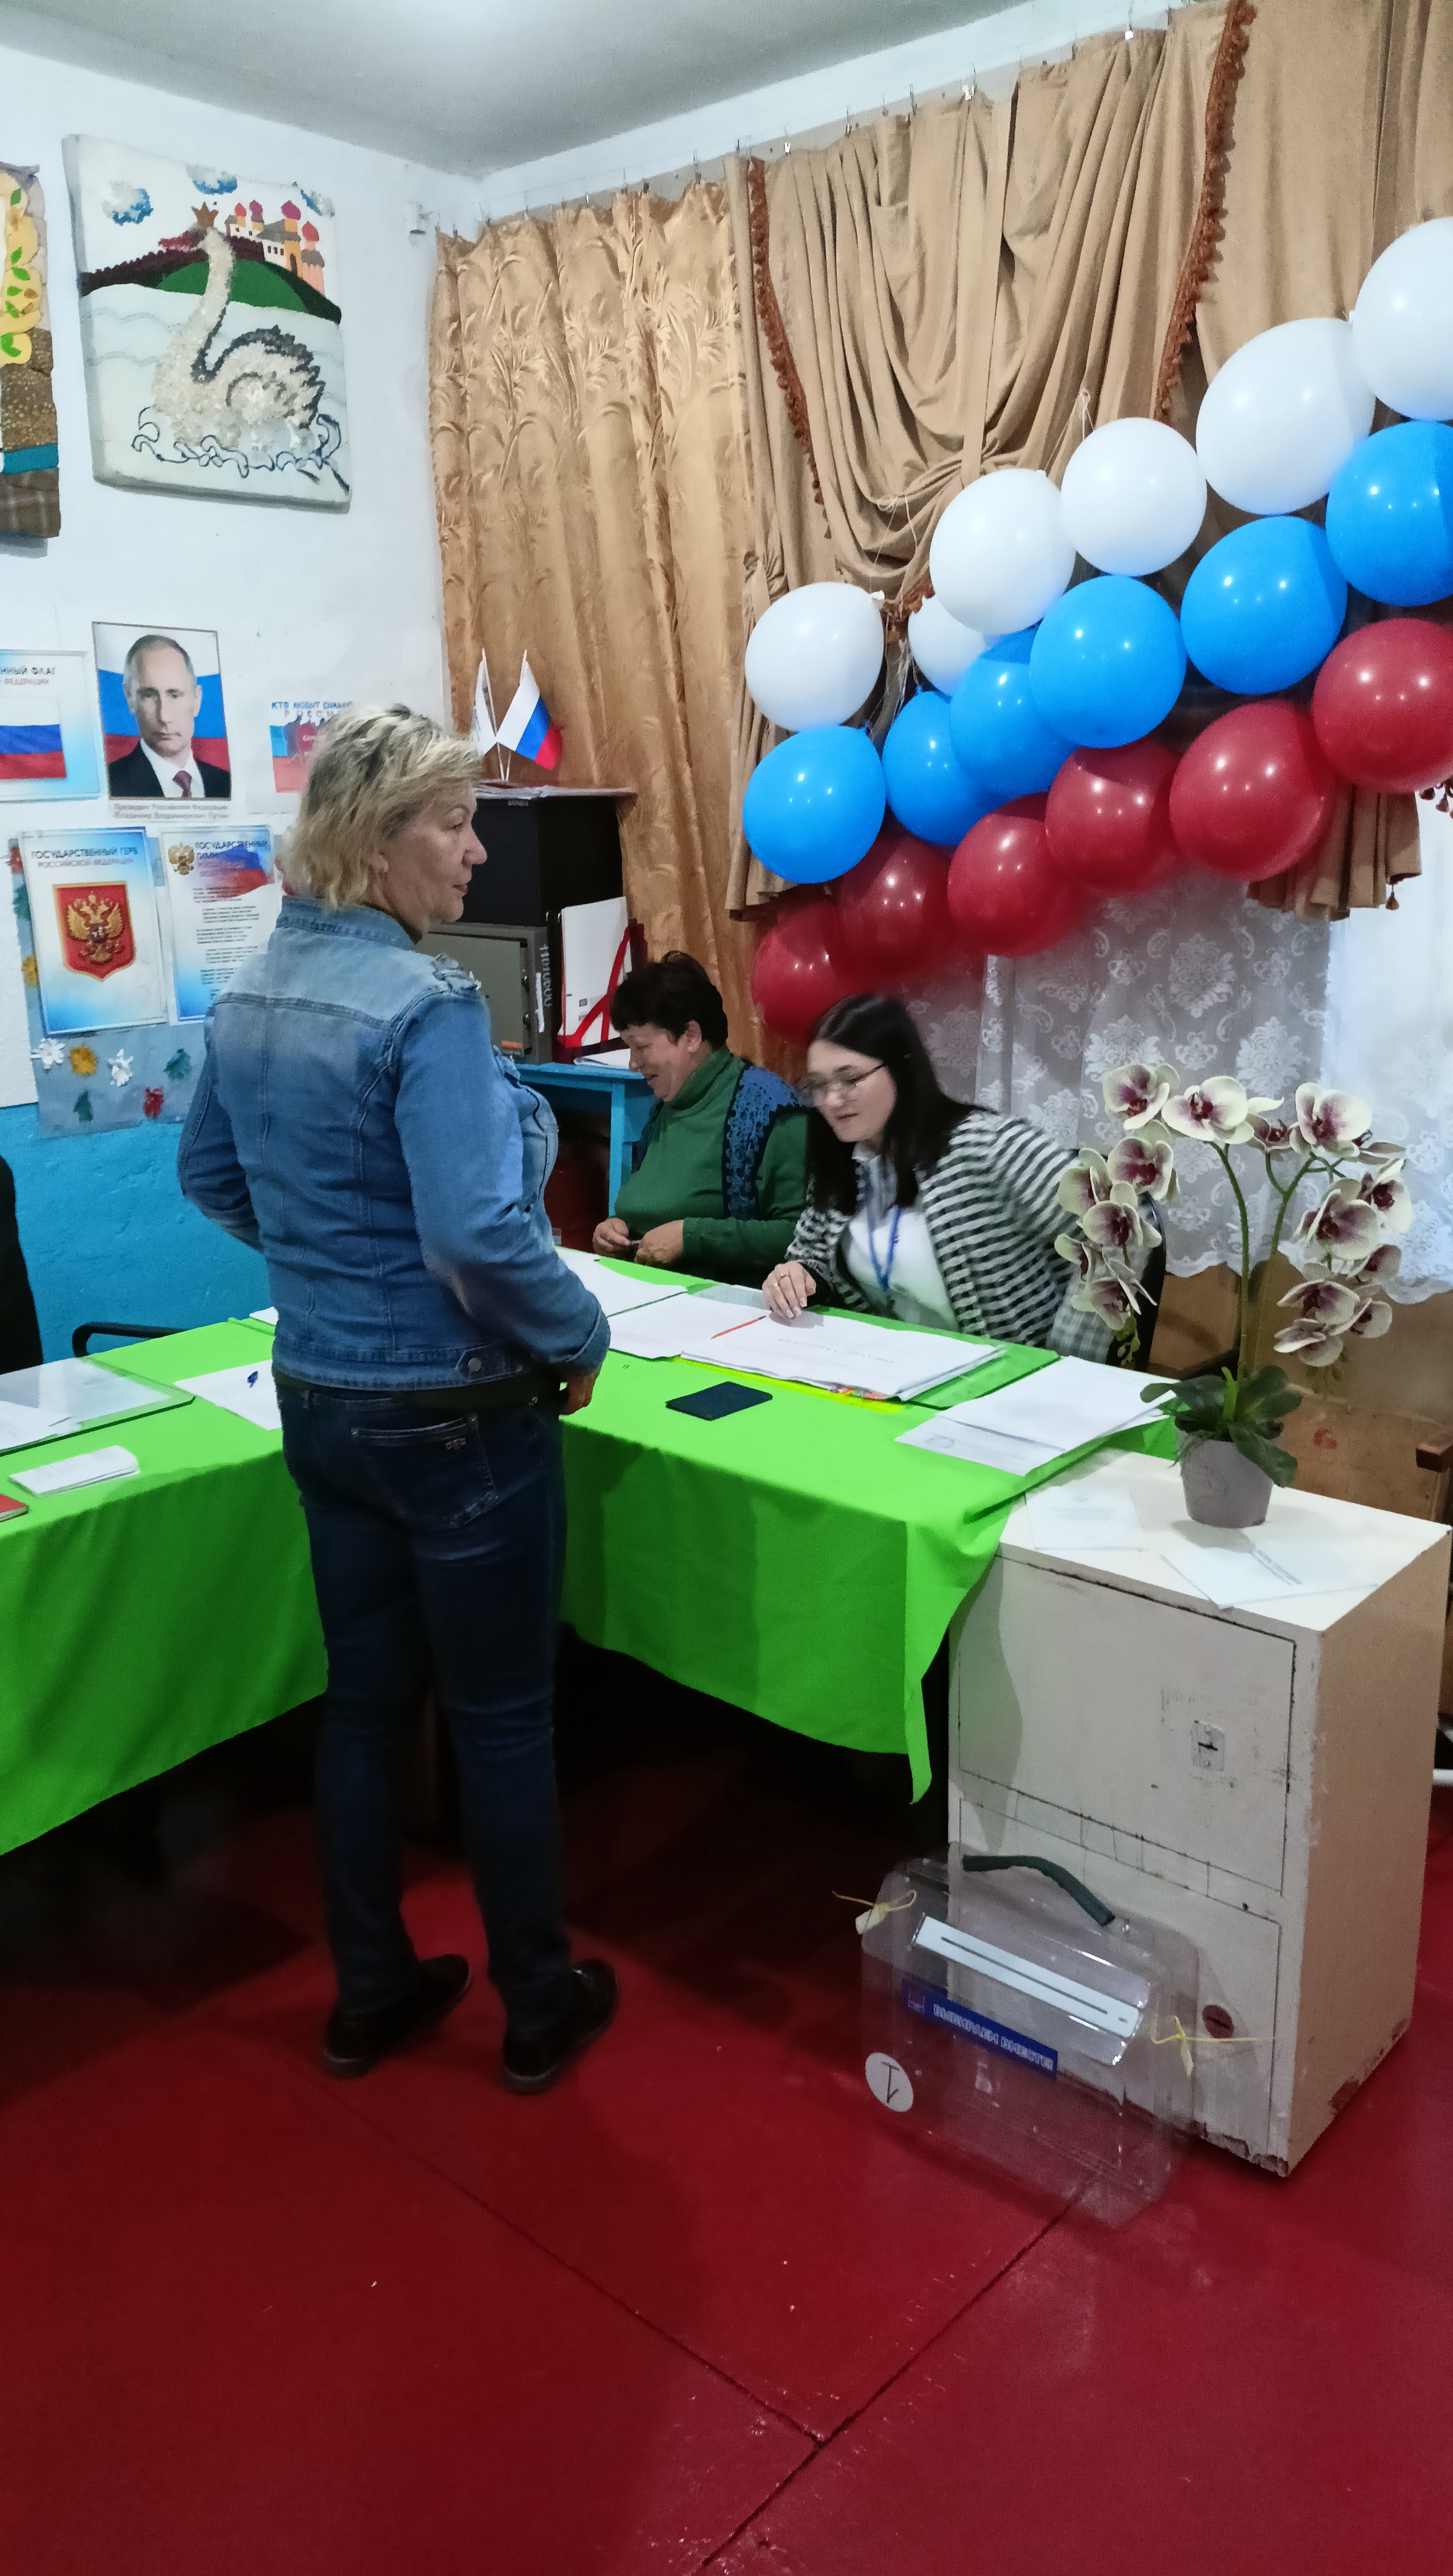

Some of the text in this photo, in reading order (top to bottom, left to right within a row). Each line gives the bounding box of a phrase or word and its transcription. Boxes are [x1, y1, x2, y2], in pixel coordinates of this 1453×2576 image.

[195, 839, 267, 850] ГОСУДАРСТВЕННЫЙ
[31, 847, 138, 859] ГОСУДАРСТВЕННЫЙ ГЕРБ
